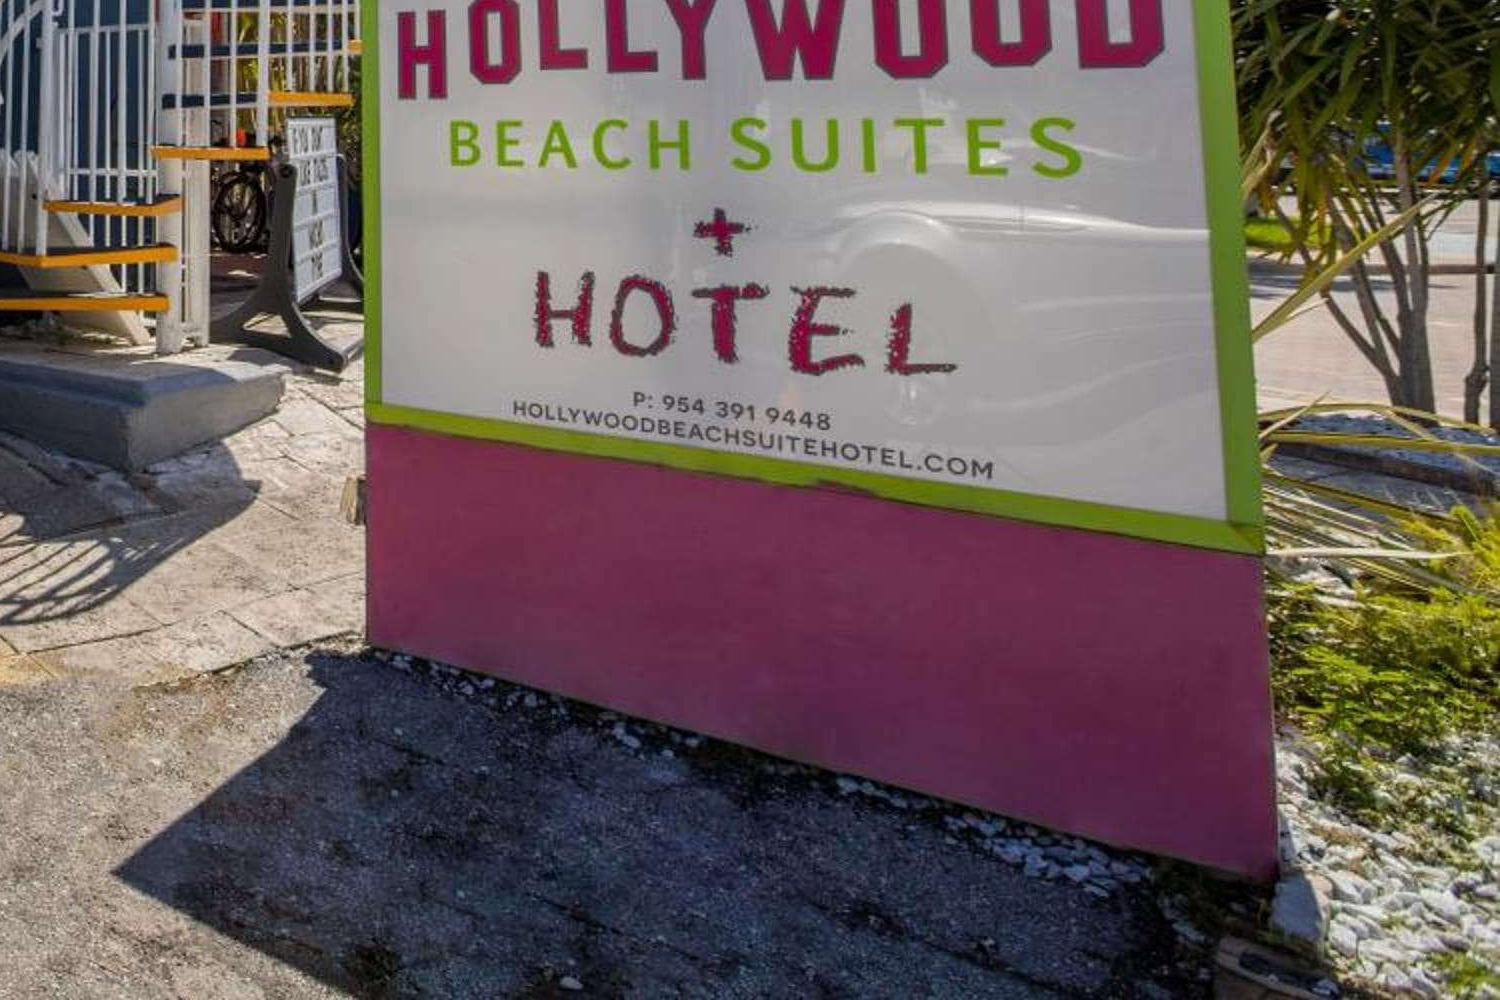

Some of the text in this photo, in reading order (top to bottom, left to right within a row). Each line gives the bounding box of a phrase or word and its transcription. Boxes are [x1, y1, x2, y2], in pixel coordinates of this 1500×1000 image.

[449, 117, 1083, 178] BEACH SUITES
[532, 270, 958, 377] HOTEL
[512, 399, 994, 480] HOLLYWOODBEACHSUITEHOTEL.COM
[632, 391, 832, 431] P: 954 391 9448
